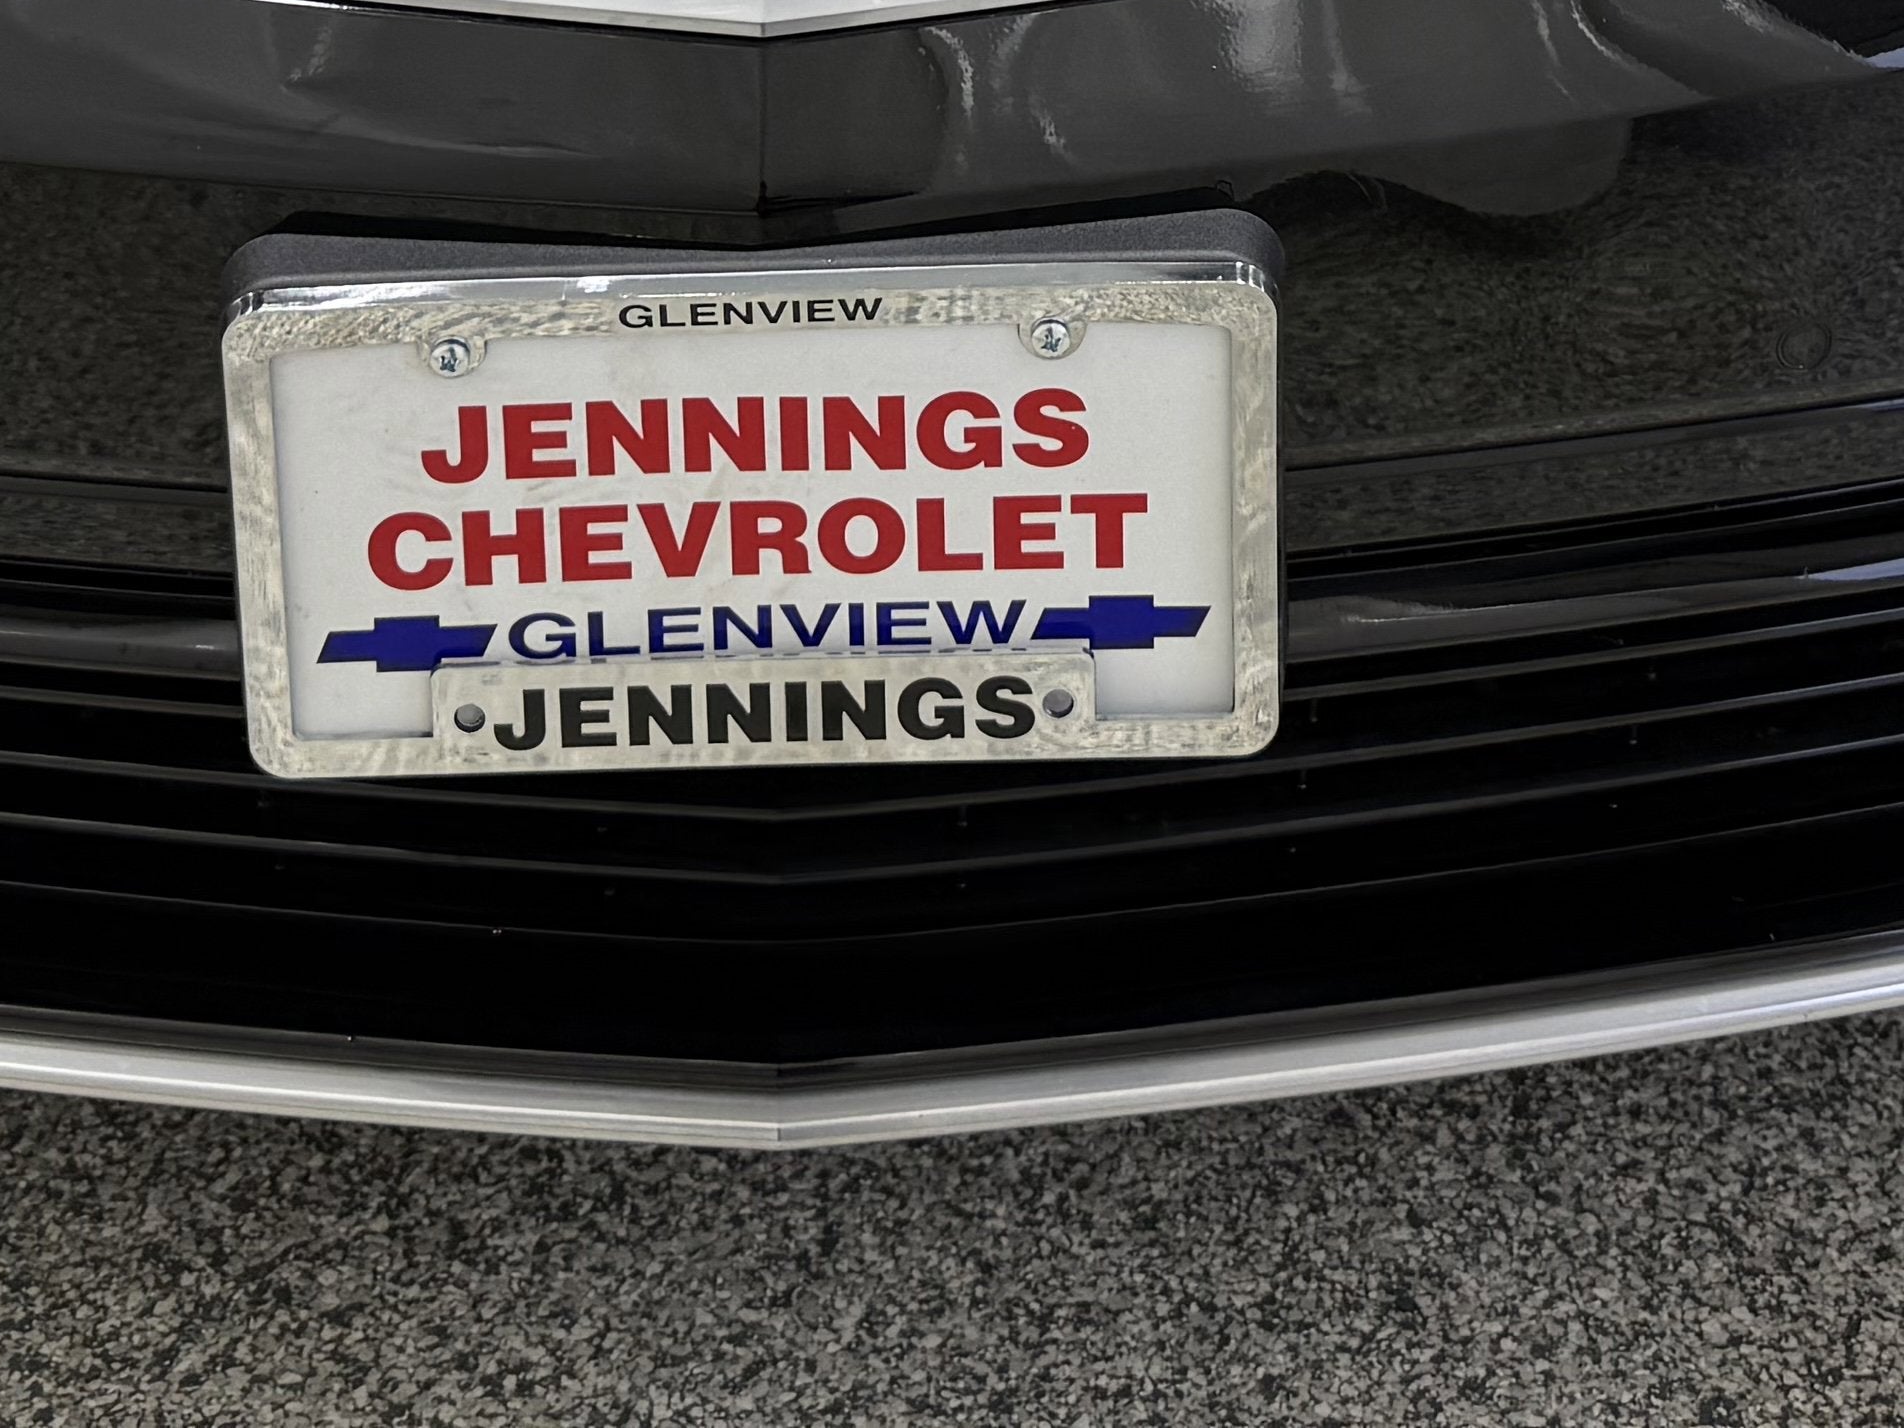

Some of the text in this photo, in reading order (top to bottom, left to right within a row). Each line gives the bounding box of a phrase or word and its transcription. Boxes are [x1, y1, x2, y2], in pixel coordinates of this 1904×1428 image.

[618, 297, 883, 329] GLENVIEW
[421, 388, 1089, 484] JENNINGS
[368, 493, 1148, 590] CHEVROLET
[507, 599, 1027, 660] GLENVIEW
[493, 675, 1037, 751] JENNINGS
